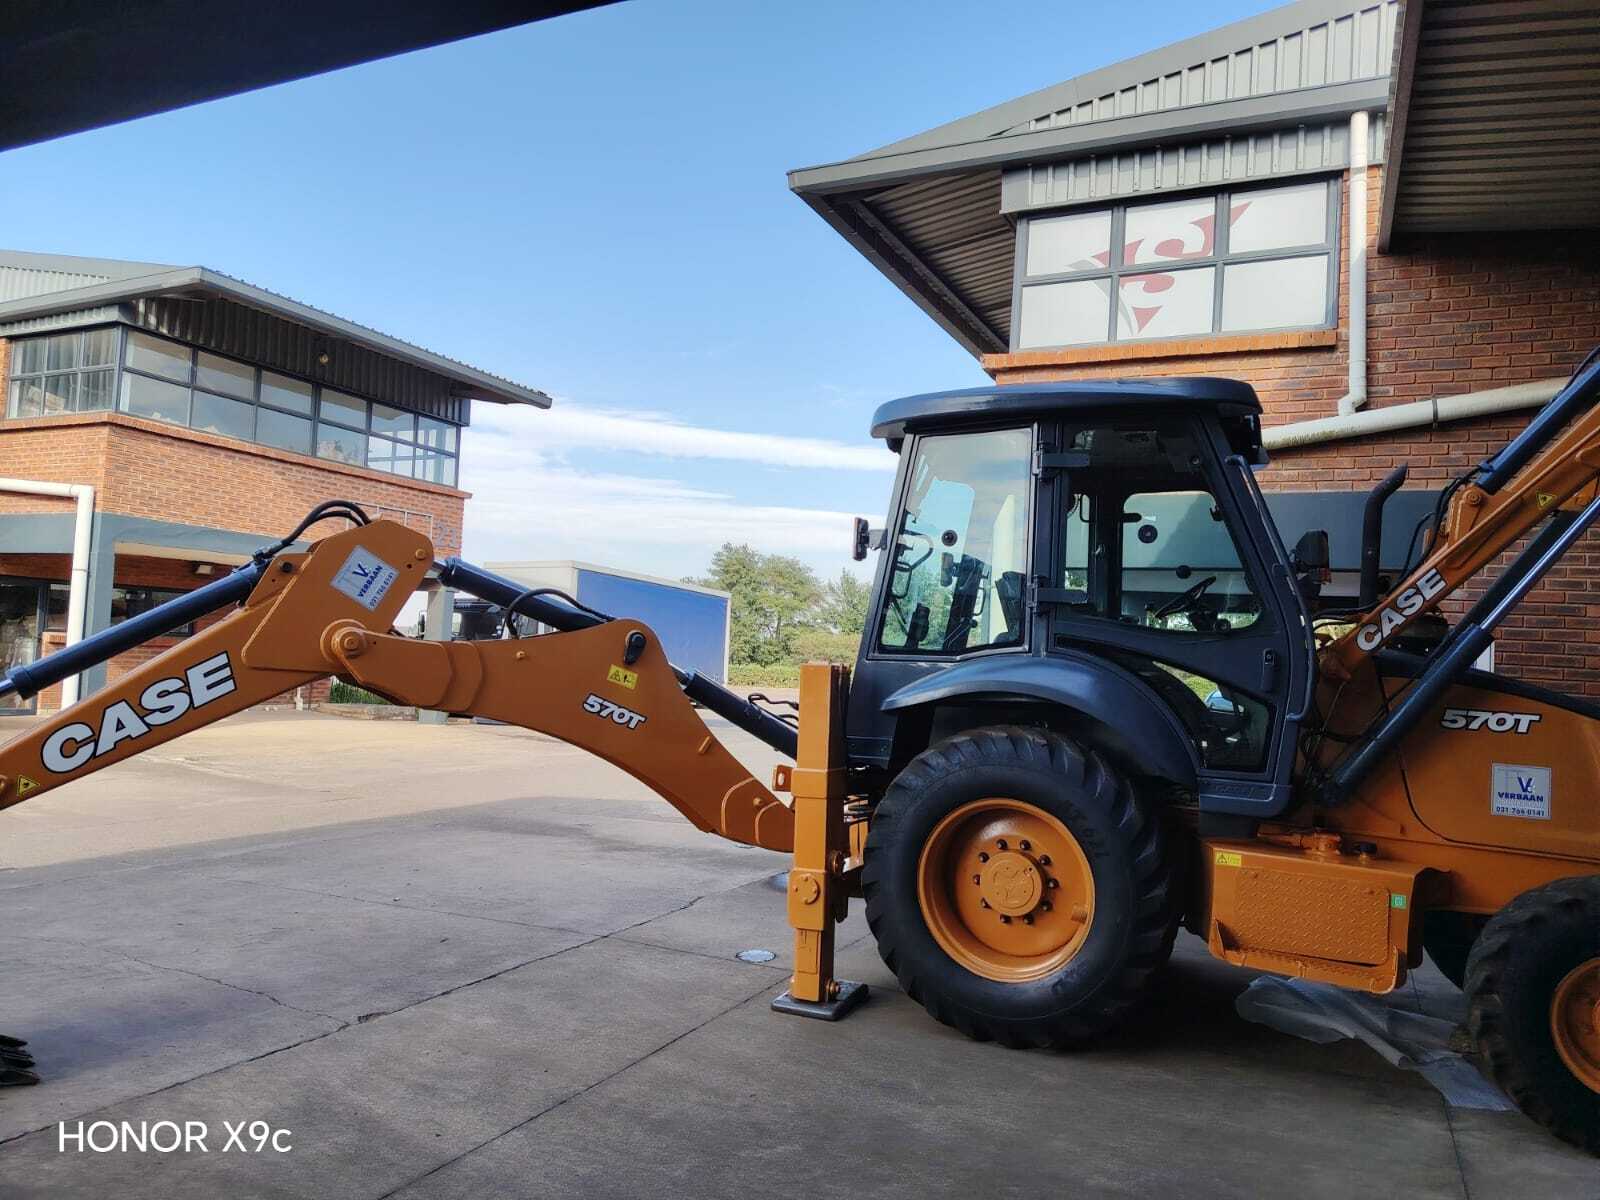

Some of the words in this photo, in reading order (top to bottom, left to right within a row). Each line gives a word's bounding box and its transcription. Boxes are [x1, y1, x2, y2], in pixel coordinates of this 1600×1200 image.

[358, 565, 383, 598] VERBAAN
[1356, 567, 1447, 651] CASE
[41, 651, 237, 773] CASE
[583, 693, 647, 729] 570T
[1440, 708, 1542, 734] 570T
[1497, 791, 1544, 802] VERBAAN
